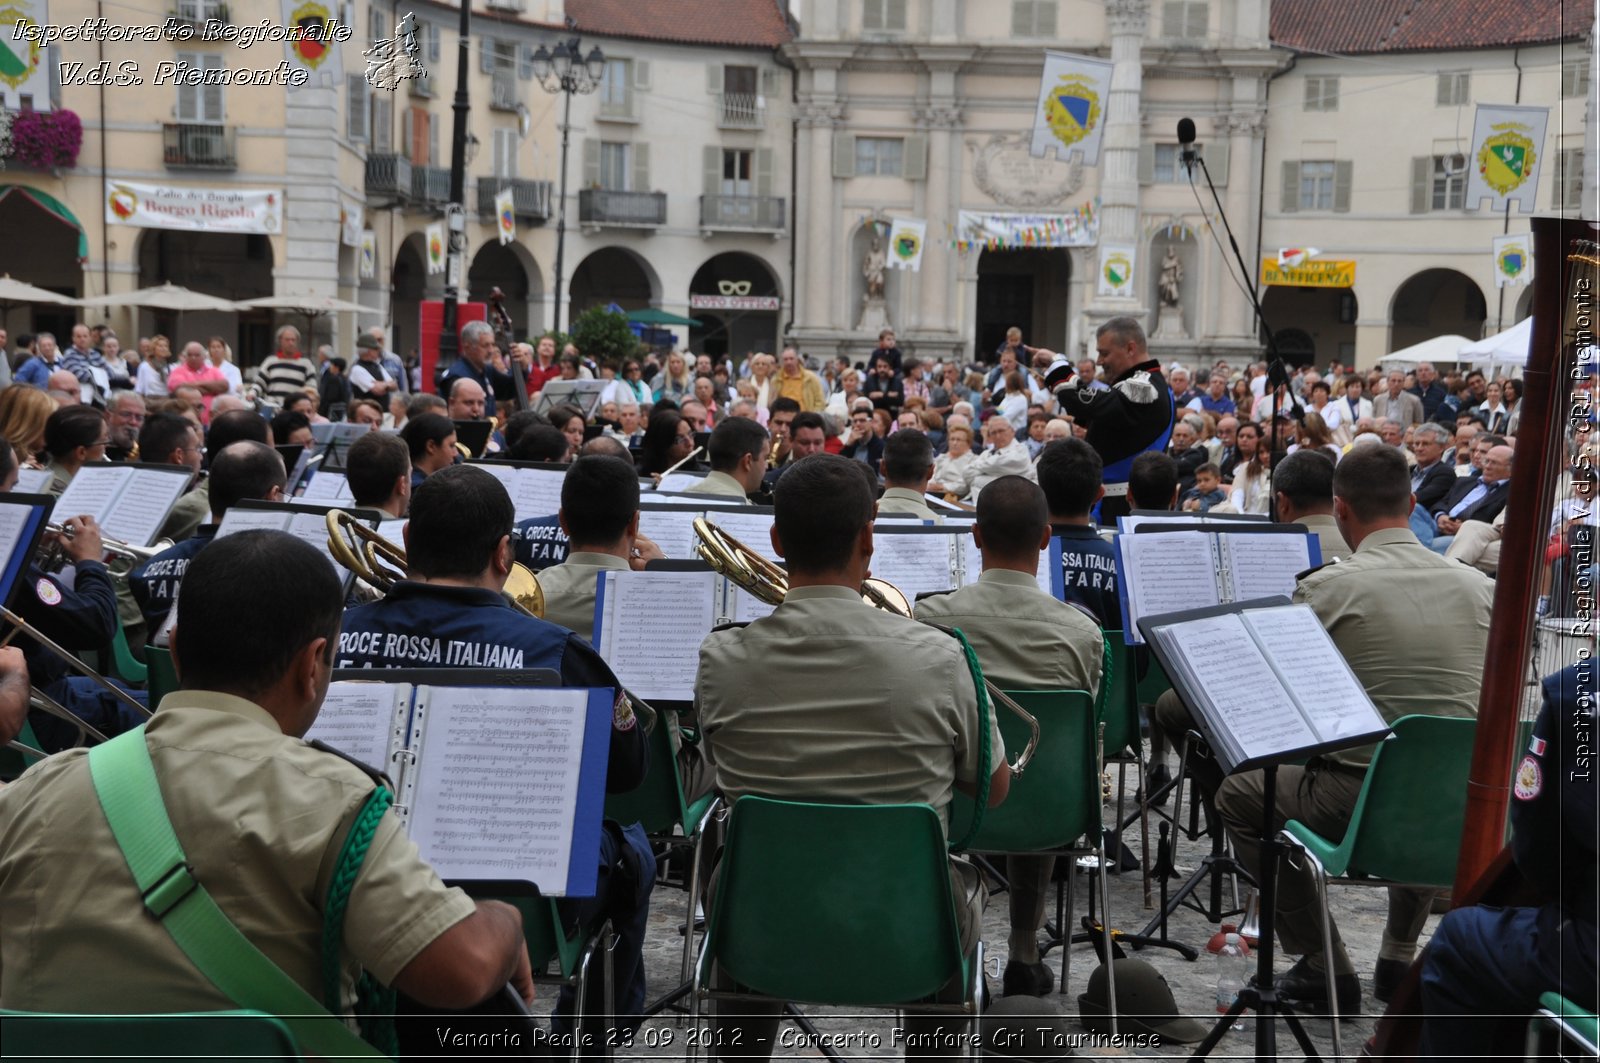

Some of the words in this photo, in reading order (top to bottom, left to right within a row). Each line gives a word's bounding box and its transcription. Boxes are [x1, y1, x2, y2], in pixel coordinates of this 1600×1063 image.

[144, 198, 196, 217] Borgo
[201, 202, 256, 219] Rigola
[1265, 270, 1350, 284] BENEFICENZA
[692, 295, 727, 308] FOTO
[730, 296, 778, 310] OTTICA
[526, 526, 556, 540] CROCE
[1085, 554, 1118, 575] ITALIA
[1065, 570, 1114, 593] FARA
[337, 631, 382, 656] ROCE
[383, 634, 441, 664] ROSSA
[446, 640, 524, 669] ITALIANA
